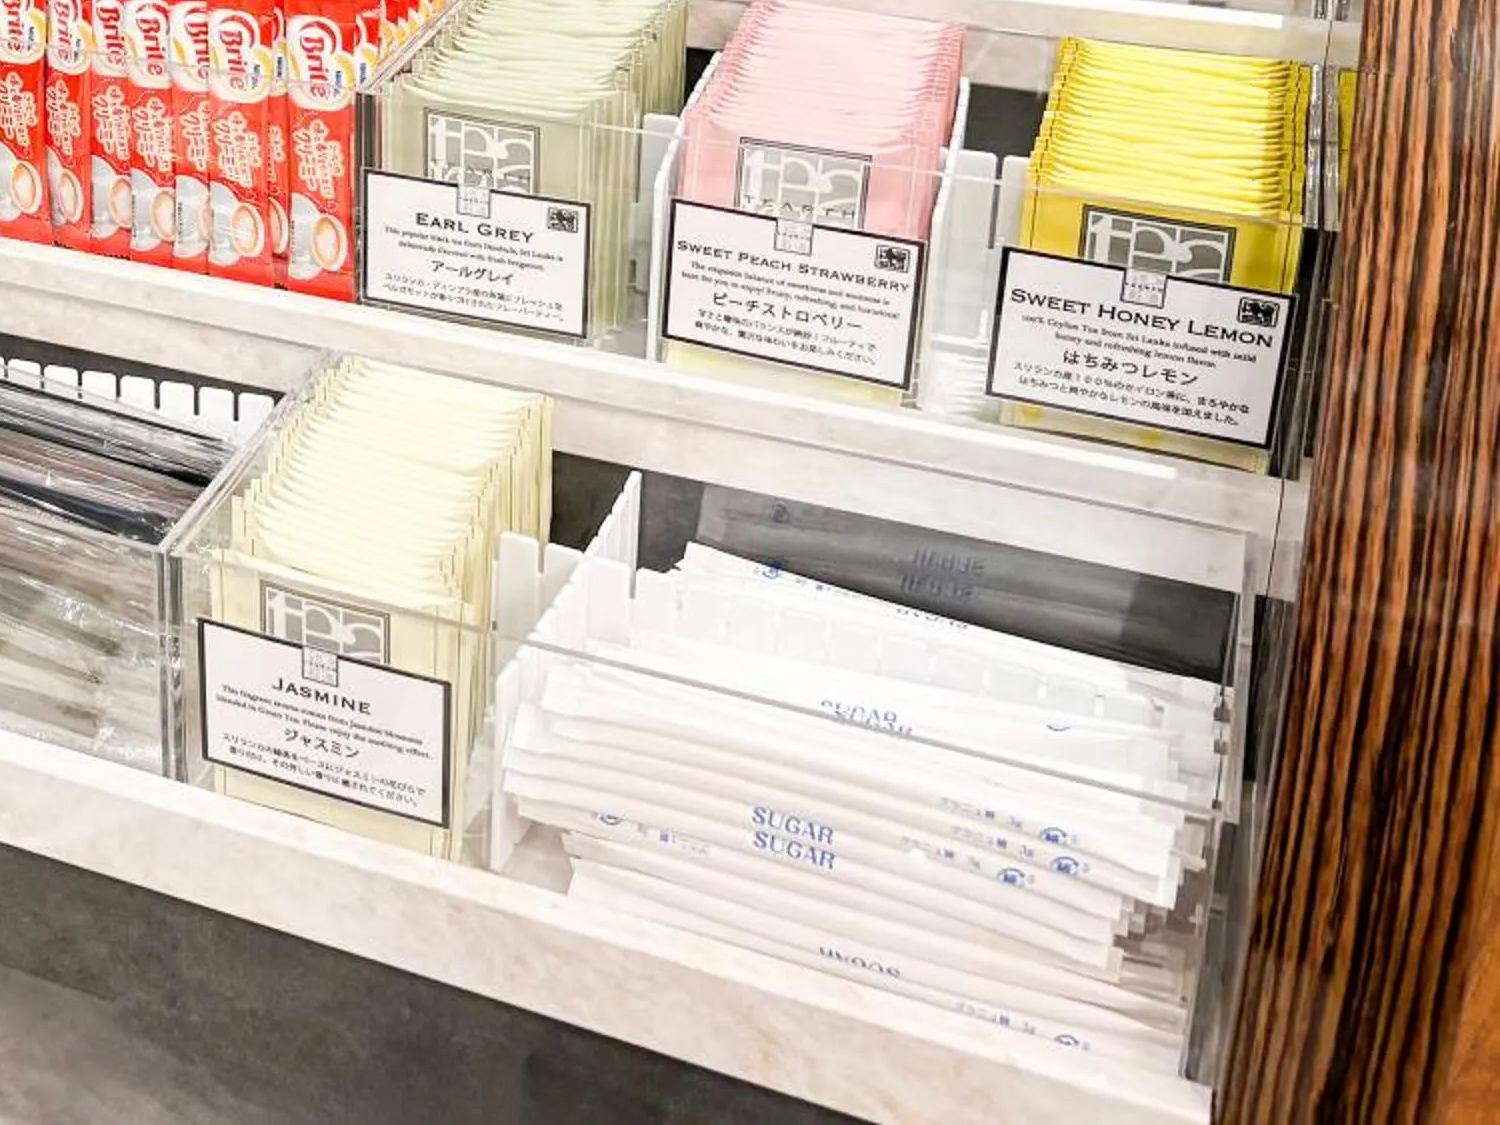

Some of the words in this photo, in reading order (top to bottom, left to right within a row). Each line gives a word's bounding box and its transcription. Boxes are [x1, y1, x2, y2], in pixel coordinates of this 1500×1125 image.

[54, 0, 72, 61] Brite
[136, 17, 166, 75] Brite
[218, 30, 247, 89] Brite
[300, 36, 331, 98] Brite
[415, 211, 469, 233] EARL
[477, 222, 534, 243] GREY
[431, 259, 513, 285] アールグレイ
[677, 239, 732, 261] SWEET
[737, 251, 791, 272] PEACH
[798, 262, 909, 294] STRAWBERRY
[713, 292, 862, 332] ピーチストロベリー
[1010, 287, 1091, 316] SWEET
[1097, 303, 1180, 332] HONEY
[1187, 319, 1273, 349] LEMON
[1084, 337, 1102, 347] and
[1141, 335, 1170, 347] Lanka
[1063, 349, 1197, 387] はちみつレモン
[272, 676, 371, 715] JASMINE
[284, 727, 360, 761] ジャスミン
[752, 806, 833, 845] SUGAR
[753, 831, 836, 869] SUGAR
